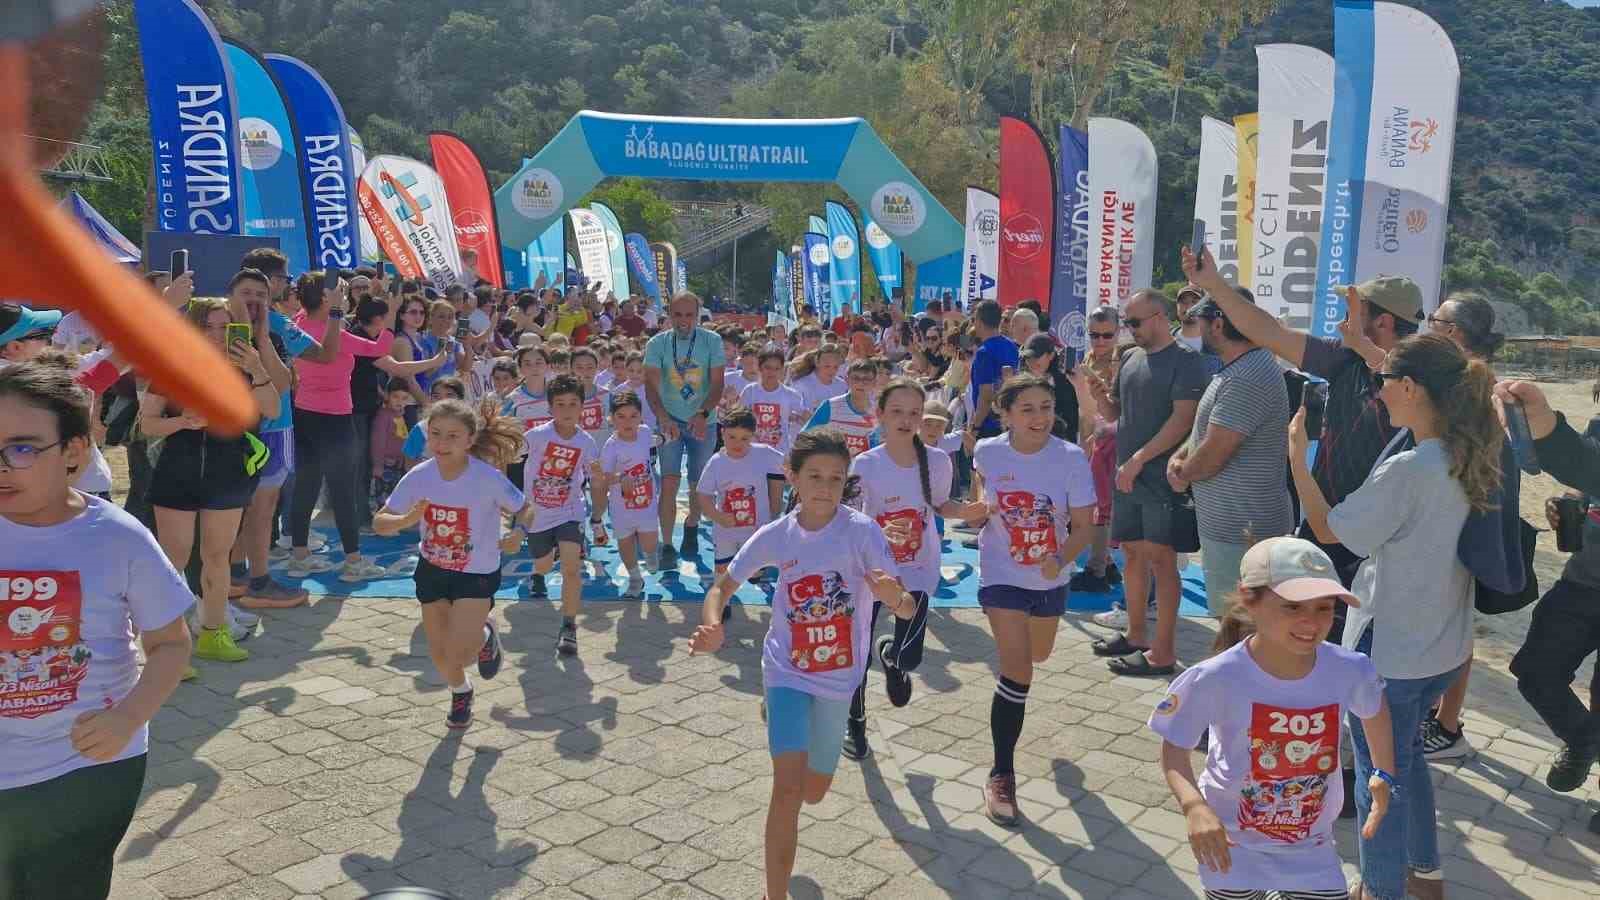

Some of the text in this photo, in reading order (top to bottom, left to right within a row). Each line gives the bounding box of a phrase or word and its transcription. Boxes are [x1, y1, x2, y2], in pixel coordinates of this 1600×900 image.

[552, 445, 576, 460] 227
[729, 500, 750, 511] 180
[431, 507, 458, 523] 198
[0, 576, 58, 601] 199
[806, 624, 837, 645] 118
[19, 679, 59, 692] Nisan
[1269, 711, 1326, 736] 203
